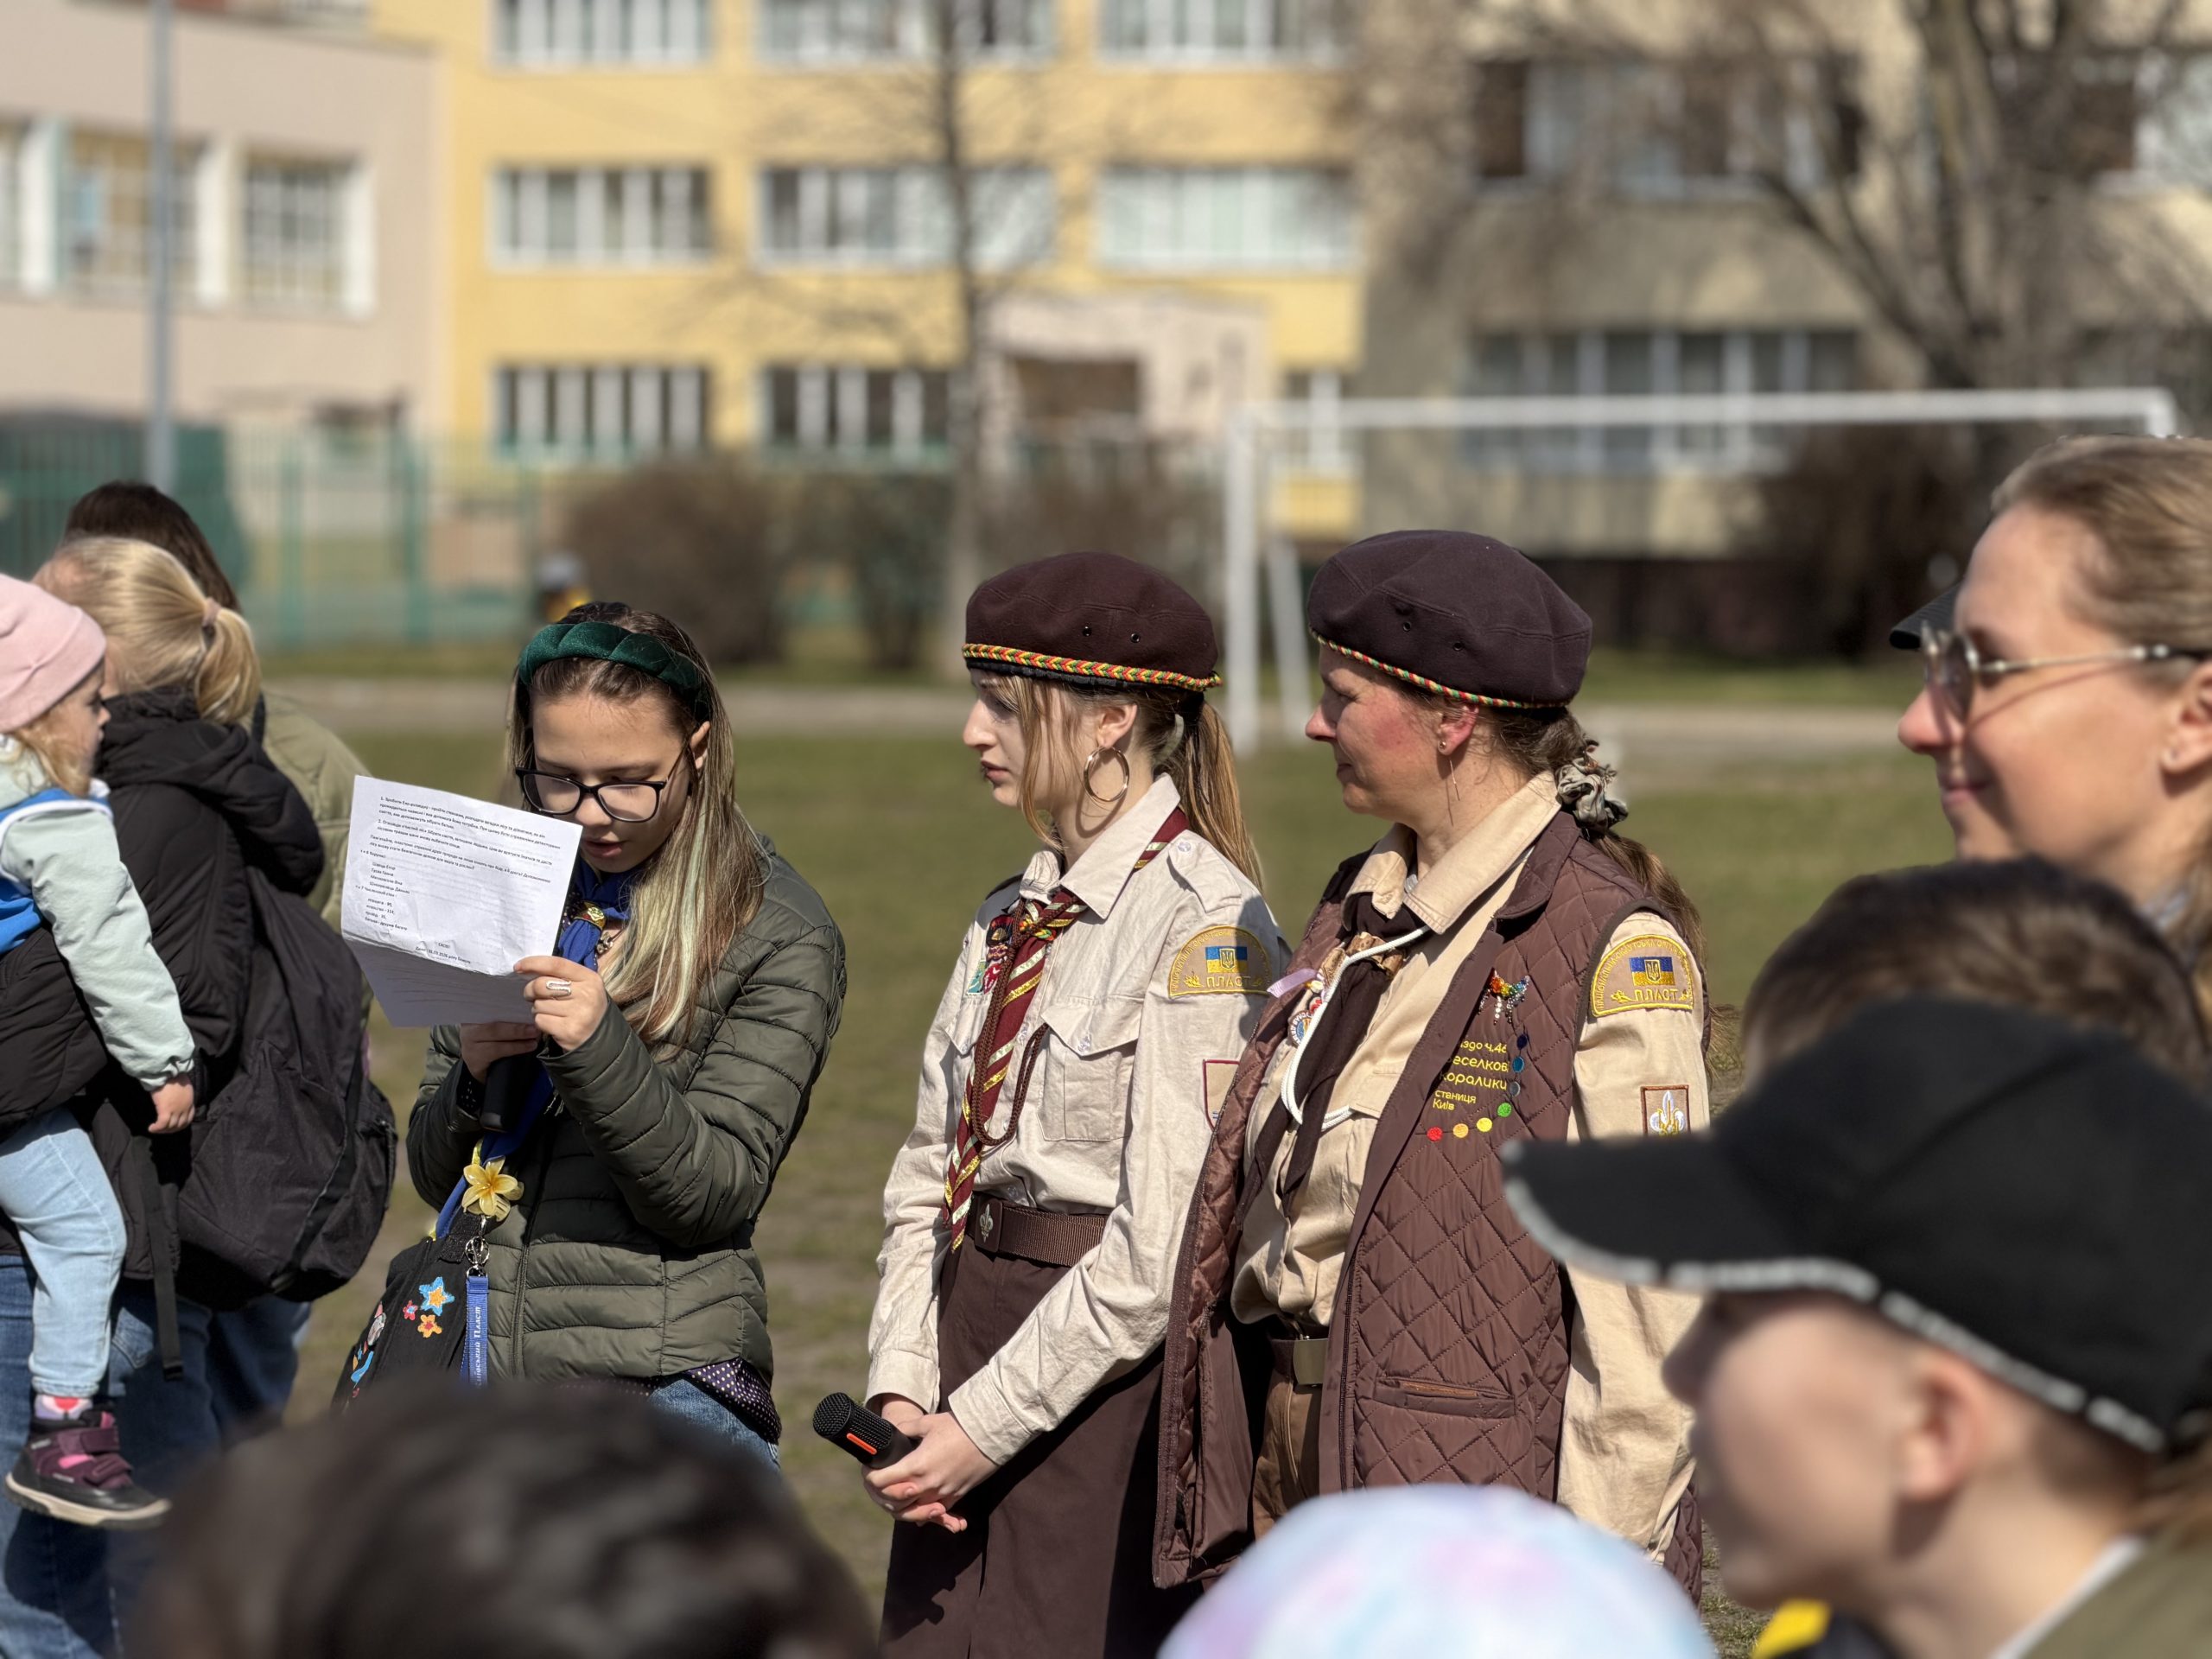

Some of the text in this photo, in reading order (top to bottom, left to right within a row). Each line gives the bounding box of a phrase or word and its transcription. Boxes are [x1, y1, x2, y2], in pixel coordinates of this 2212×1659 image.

[1206, 976, 1251, 988] ПЛАСТ
[1635, 988, 1678, 1001] ПЛАСТ
[1434, 1090, 1477, 1103] станиця
